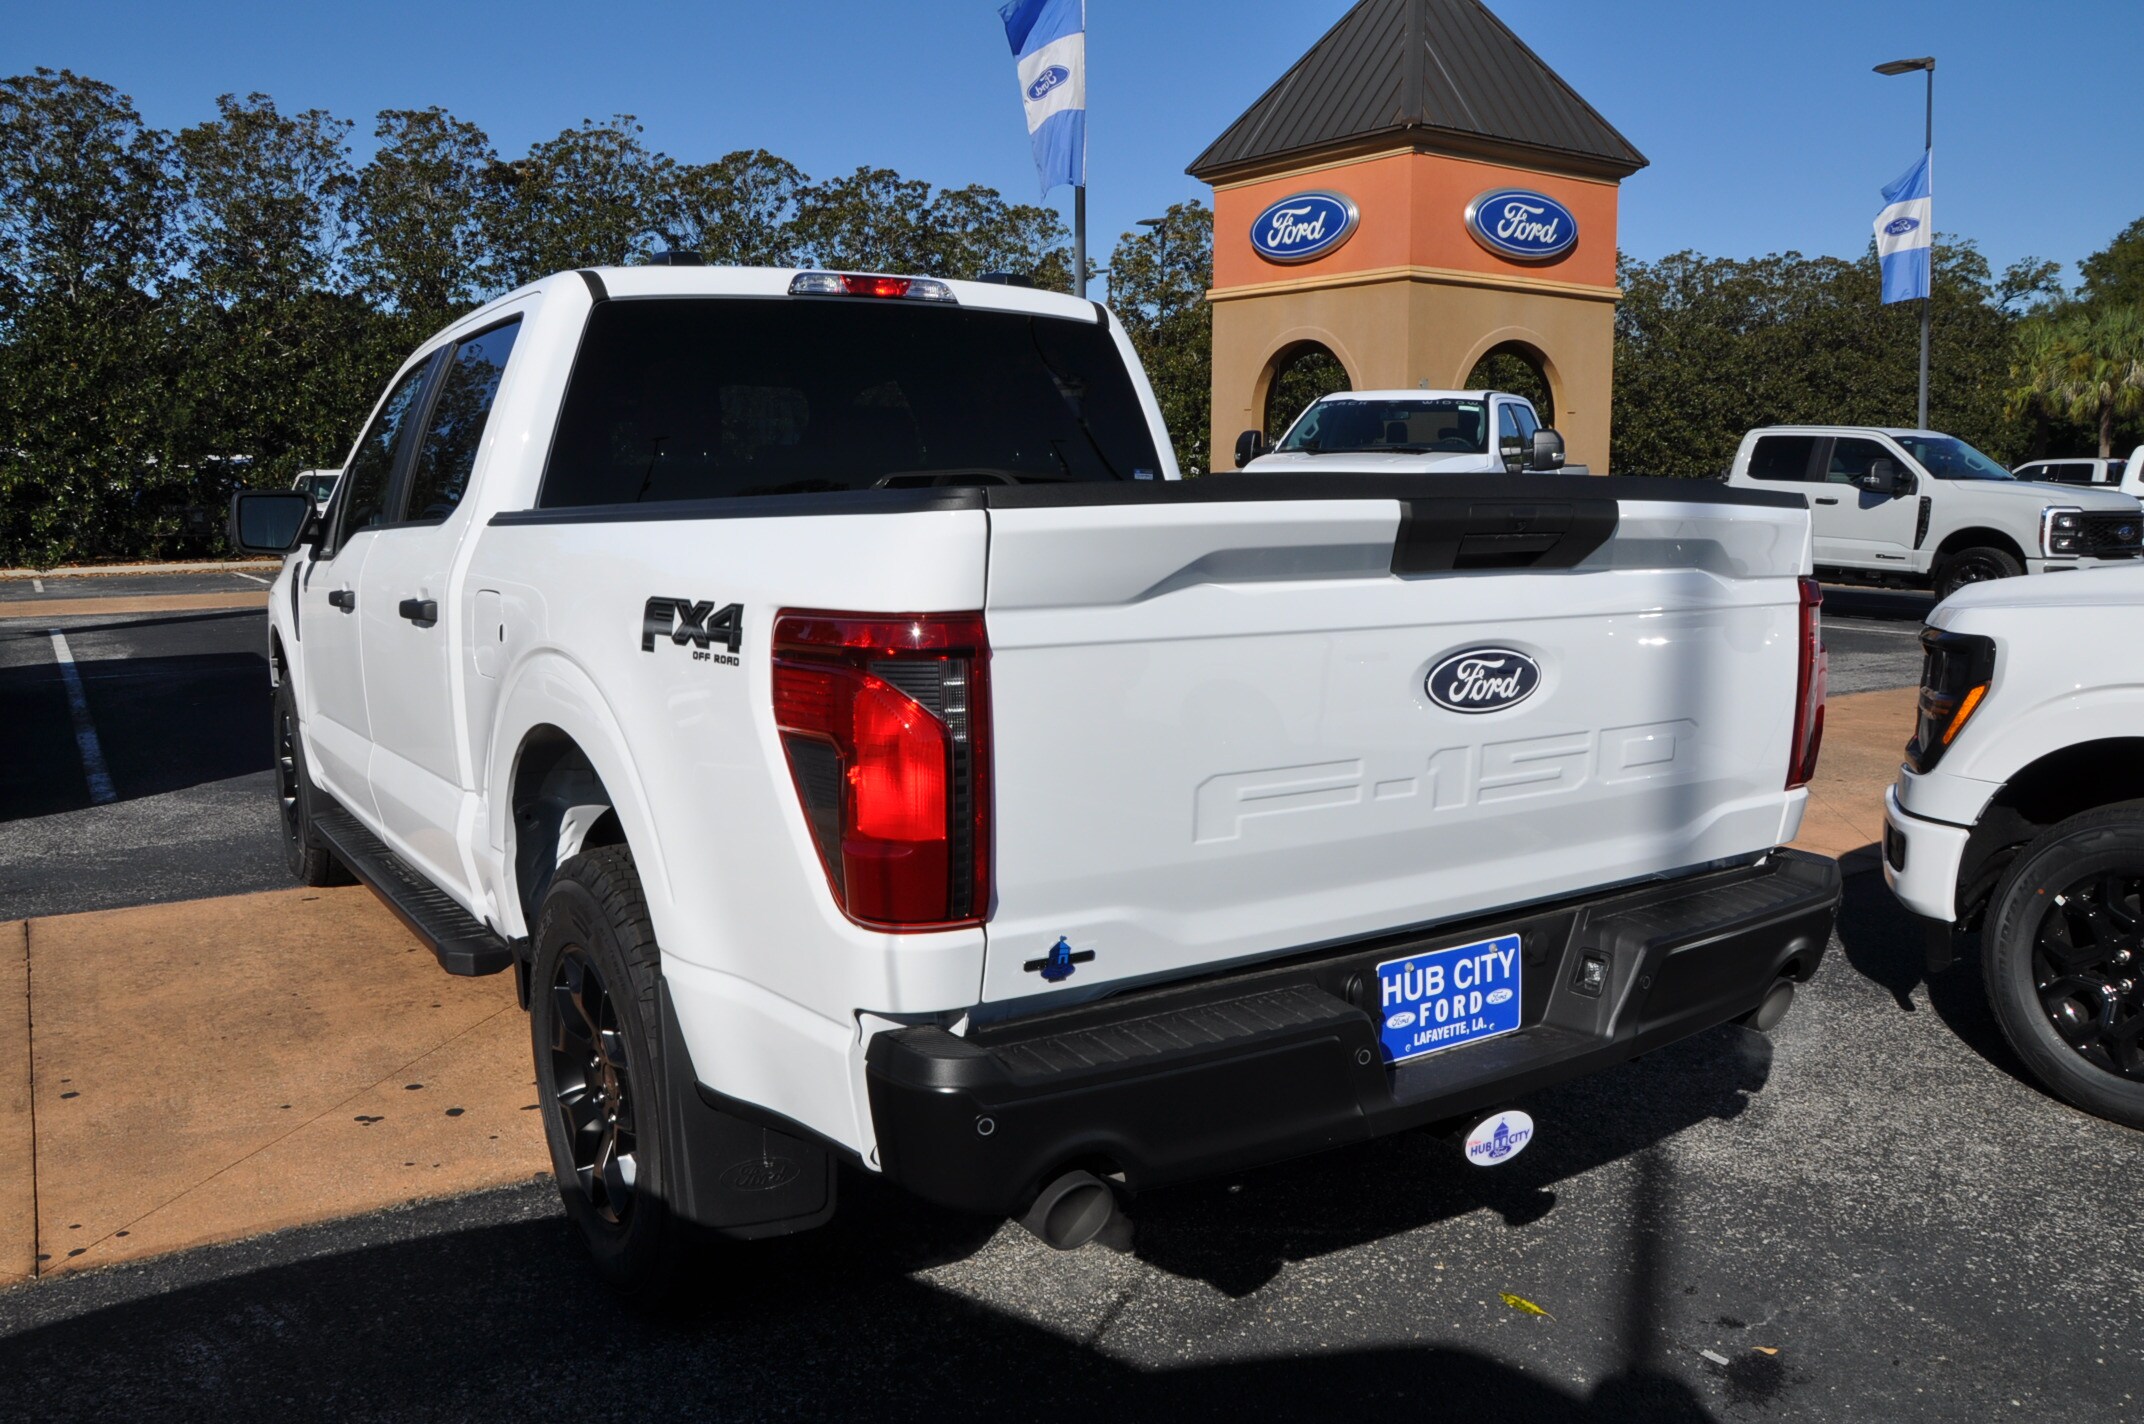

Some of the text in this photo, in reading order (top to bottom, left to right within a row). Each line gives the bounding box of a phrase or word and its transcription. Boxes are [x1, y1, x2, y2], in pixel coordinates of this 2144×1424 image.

[1266, 205, 1326, 248] Ford
[1497, 202, 1558, 244] Ford
[641, 595, 744, 654] FX4
[692, 650, 740, 667] OFF ROAD
[1448, 658, 1522, 702] Ford
[1192, 717, 1700, 845] F-150
[1382, 948, 1516, 1007] HUB CITY
[1419, 991, 1483, 1027] FORD
[1413, 1017, 1487, 1046] LAFAYETTE, LA.
[1470, 1141, 1492, 1157] HUB
[1508, 1129, 1531, 1144] CITY
